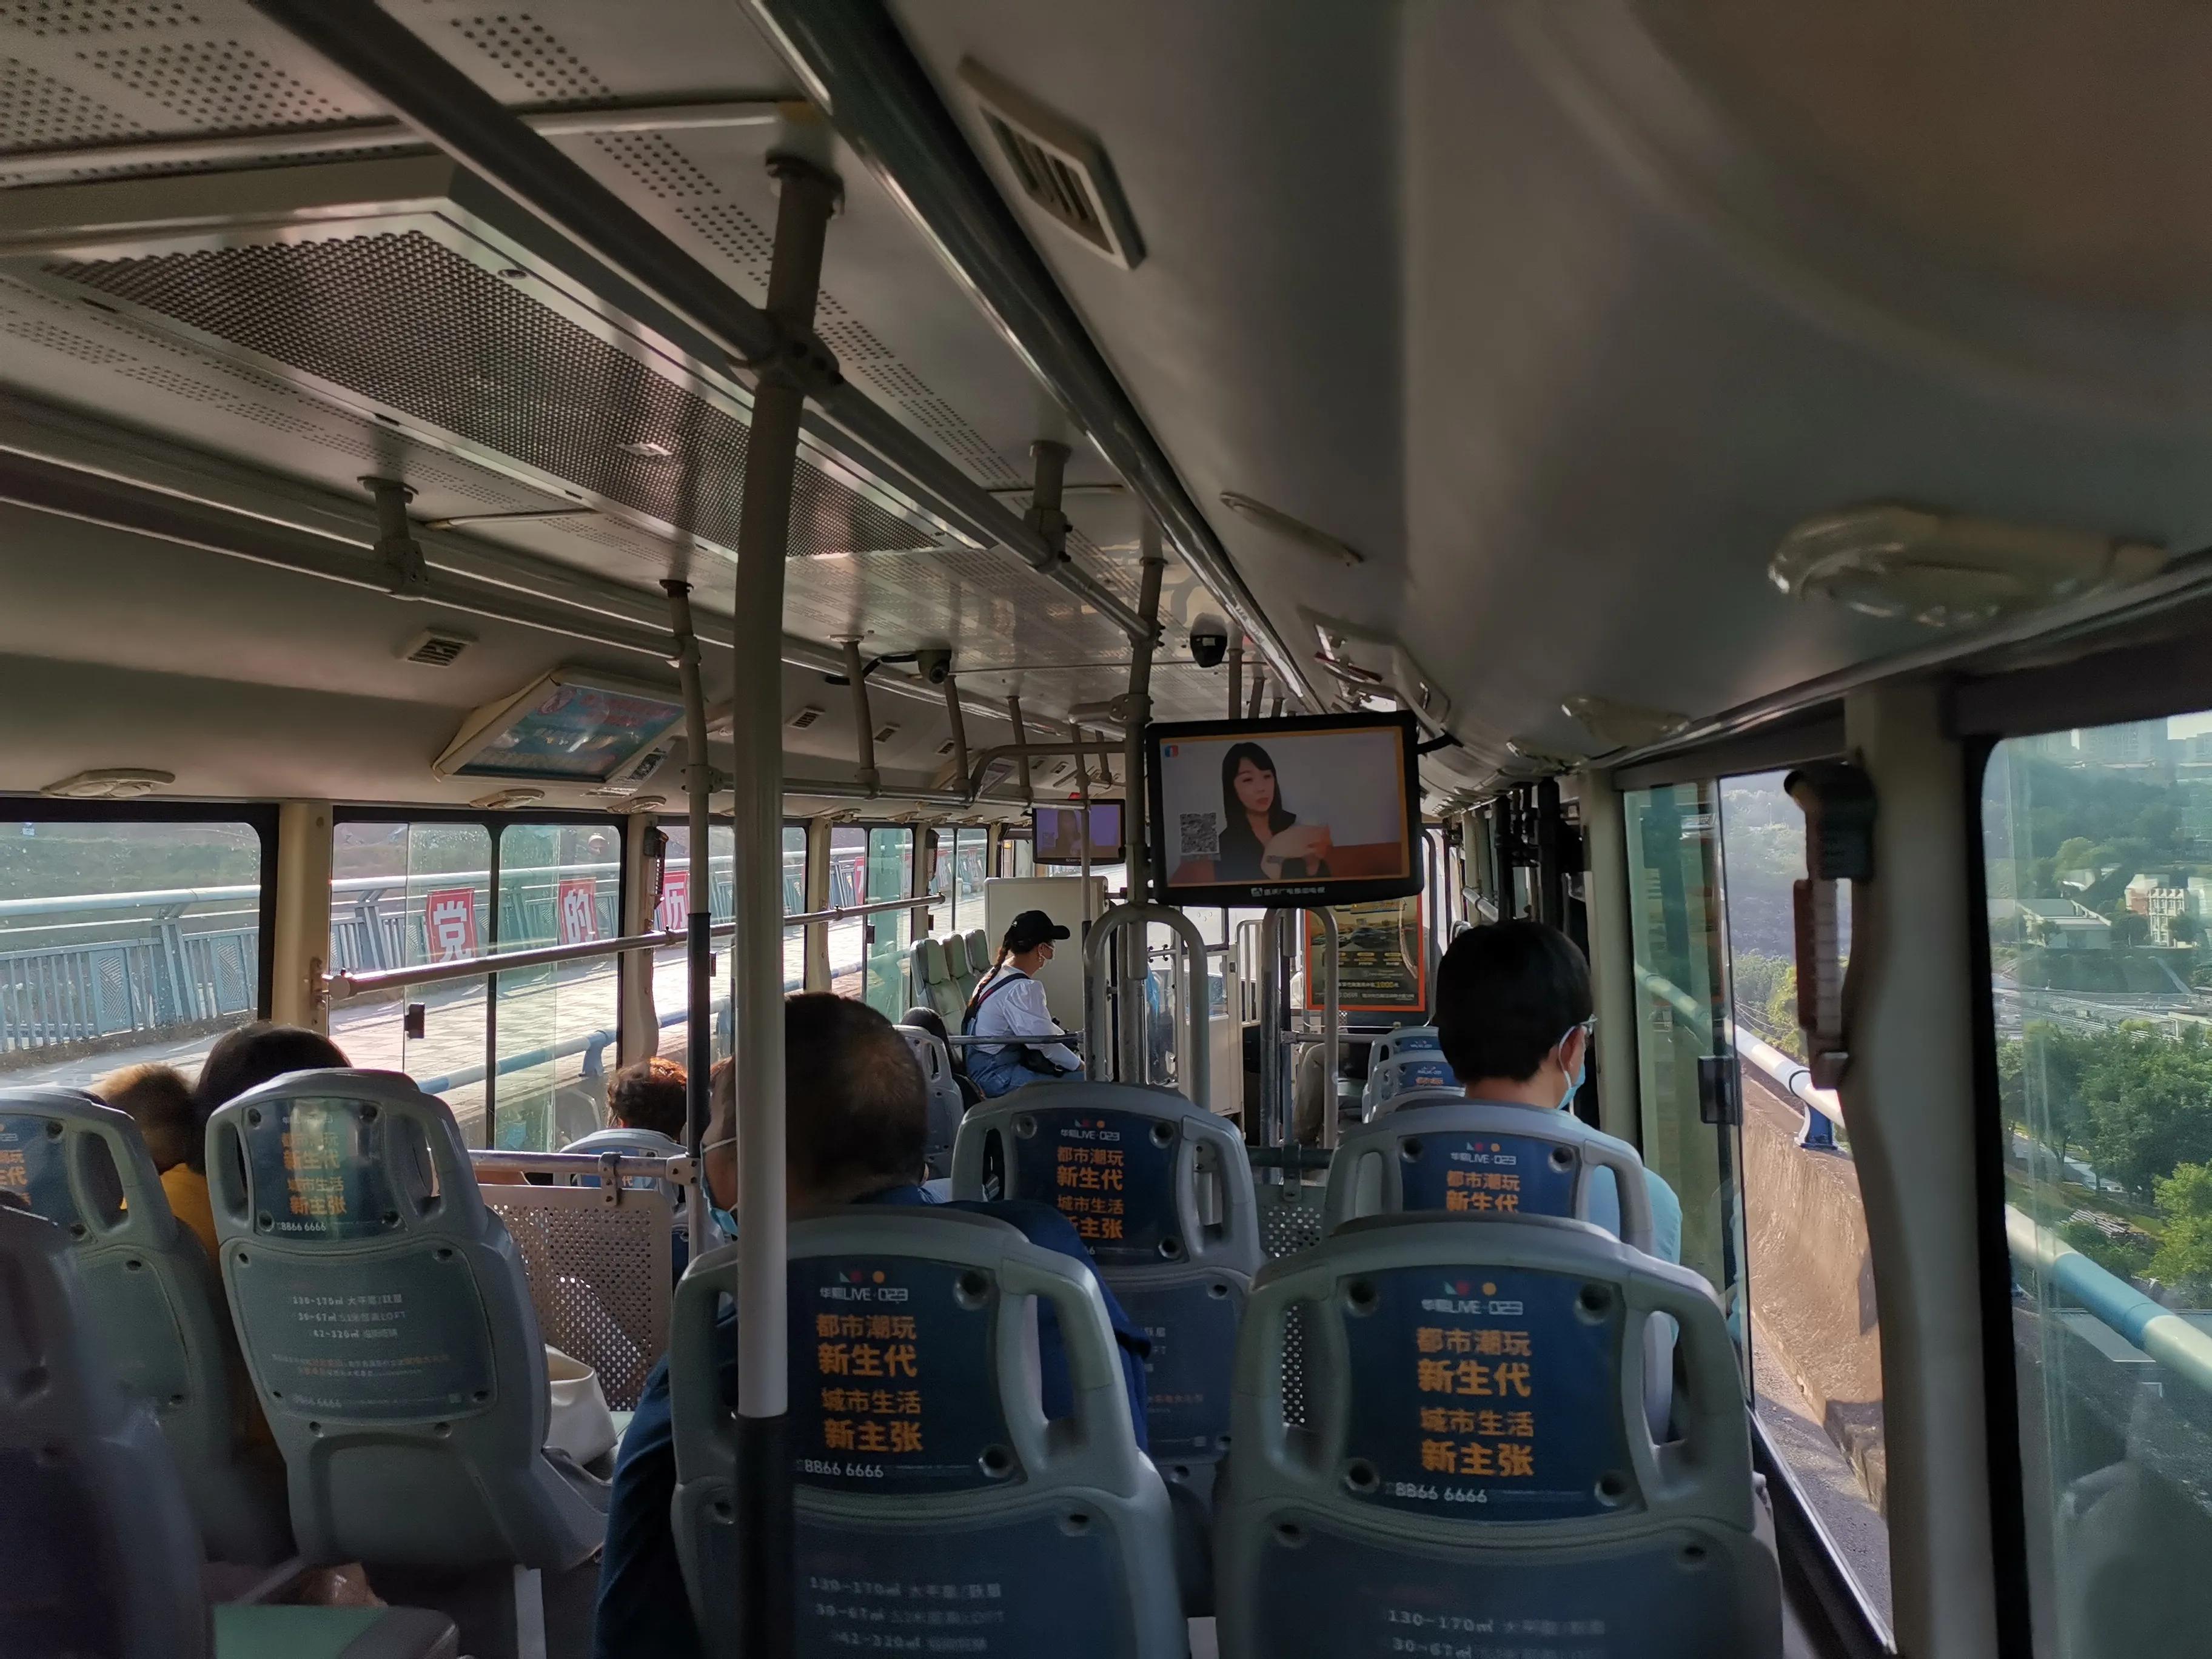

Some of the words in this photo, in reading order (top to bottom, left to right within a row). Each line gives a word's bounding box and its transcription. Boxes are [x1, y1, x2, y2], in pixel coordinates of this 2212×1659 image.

[564, 890, 593, 943] 的
[665, 882, 688, 929] 历
[434, 901, 471, 962] 党
[1057, 1146, 1124, 1167] 都市潮玩
[1057, 1165, 1123, 1190] 新生代
[1447, 1170, 1520, 1191] 都市潮玩
[290, 1196, 347, 1215] 新主张
[1057, 1195, 1124, 1215] 城市生活
[1446, 1190, 1519, 1213] 新生代
[281, 1222, 302, 1231] 8866
[304, 1222, 326, 1232] 6666
[816, 1315, 916, 1339] 都市潮玩
[1417, 1327, 1532, 1356] 都市潮玩
[818, 1342, 918, 1377] 新生代
[1418, 1359, 1532, 1397] 新生代
[821, 1387, 922, 1413] 城市生活
[1420, 1407, 1534, 1437] 城市生活
[824, 1418, 923, 1452] 新主张
[805, 1460, 841, 1476] 8866
[846, 1461, 883, 1478] 6666
[1421, 1439, 1534, 1476] 新主张
[1395, 1482, 1438, 1500] 8866
[1444, 1487, 1487, 1503] 6666
